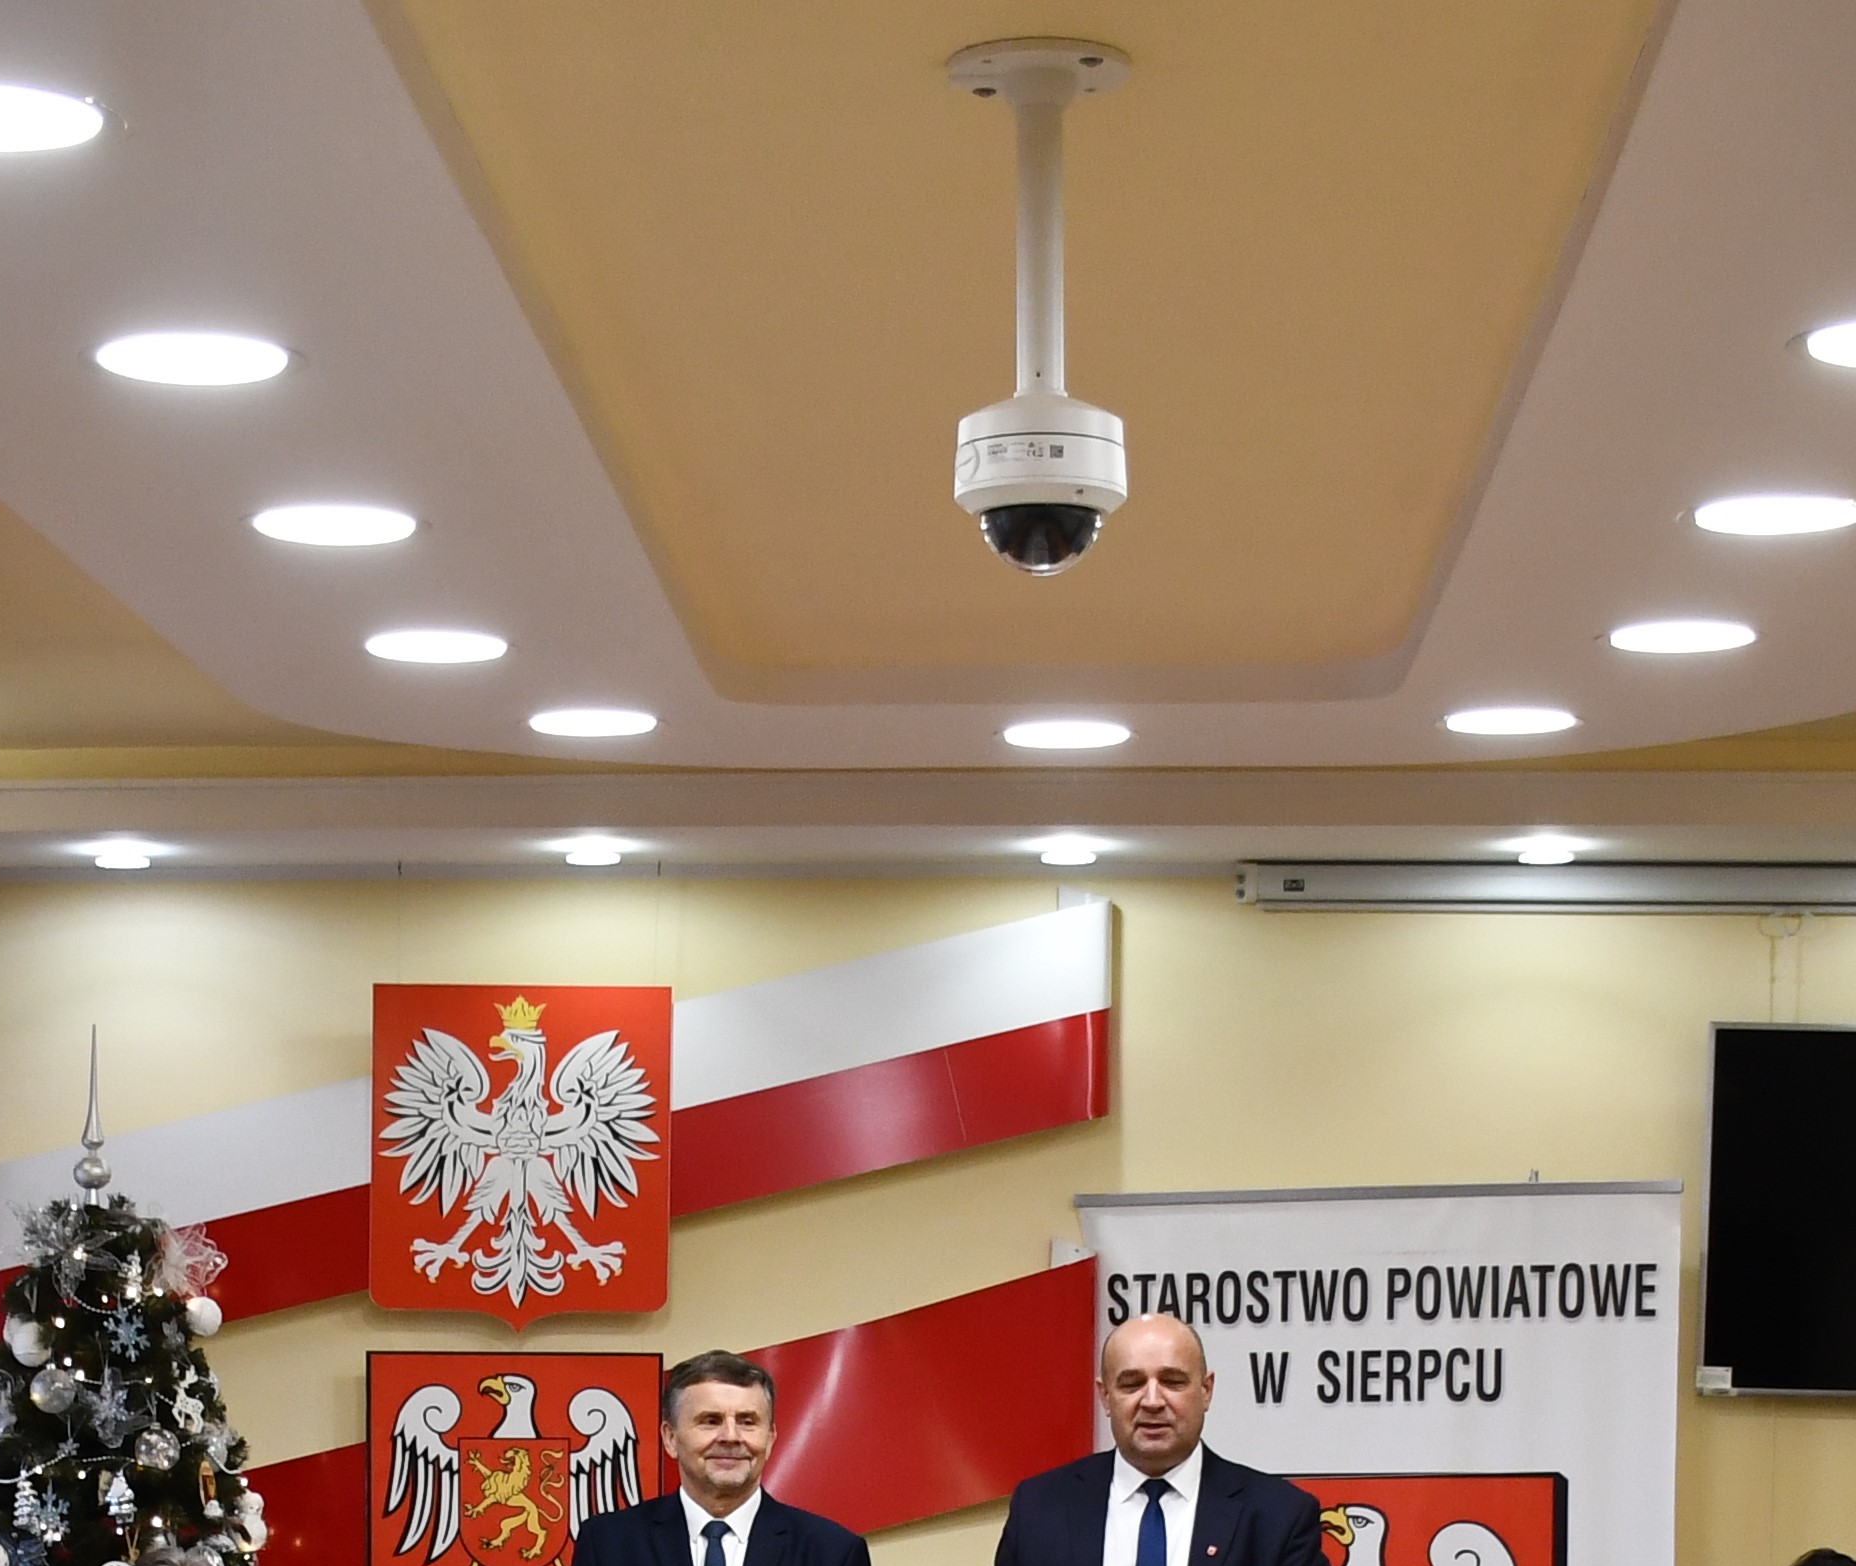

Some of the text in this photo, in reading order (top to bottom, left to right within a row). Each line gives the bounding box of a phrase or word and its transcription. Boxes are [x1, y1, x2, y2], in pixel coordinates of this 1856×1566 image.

[1107, 1263, 1657, 1325] STAROSTWO POWIATOWE
[1250, 1347, 1504, 1404] W SIERPCU
